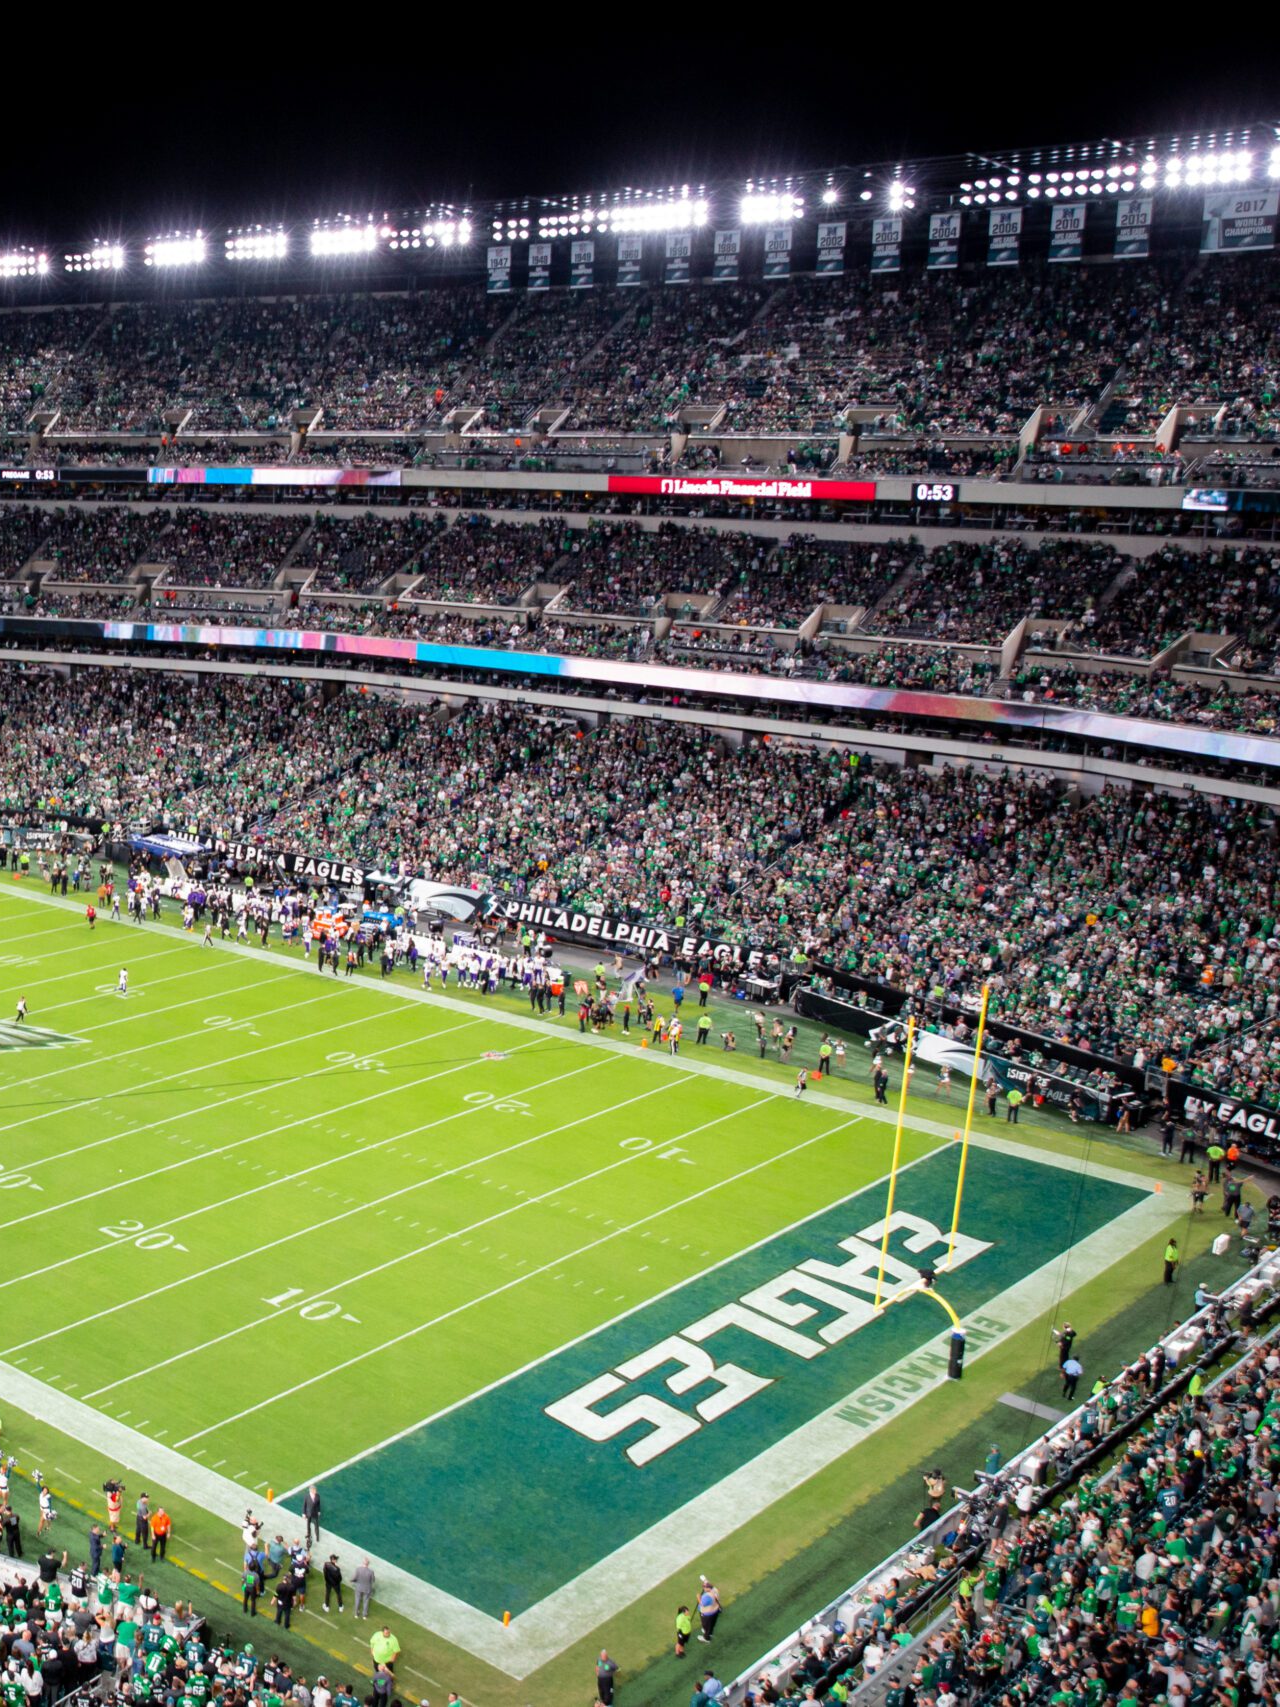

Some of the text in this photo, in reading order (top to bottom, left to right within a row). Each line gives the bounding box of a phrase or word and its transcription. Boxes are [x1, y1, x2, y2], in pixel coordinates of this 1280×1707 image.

[1235, 200, 1267, 213] 2017
[1055, 218, 1080, 230] 2010
[1121, 213, 1147, 225] 2013
[1234, 217, 1264, 227] WORLD
[932, 227, 957, 239] 2004
[992, 222, 1018, 235] 2006
[1224, 225, 1273, 237] CHAMPIONS
[820, 236, 843, 247] 2002
[875, 232, 900, 242] 2003
[718, 243, 737, 252] 1988
[769, 240, 789, 250] 2001
[490, 258, 508, 267] 1947
[35, 470, 55, 480] 0:53
[673, 479, 812, 497] Lincoln Financial Field
[916, 484, 953, 500] 0:53
[294, 856, 364, 886] EAGLES
[506, 901, 764, 970] PHILADELPHIA EAGLE
[1040, 1087, 1070, 1103] EAGLE
[463, 1091, 531, 1114] 20
[1217, 1103, 1280, 1140] EAGL
[619, 1136, 690, 1160] 10
[98, 1218, 175, 1251] 20
[261, 1286, 342, 1321] 10
[544, 1210, 995, 1467] EAGLES
[833, 1351, 950, 1429] RACISM
[148, 1633, 159, 1643] 11
